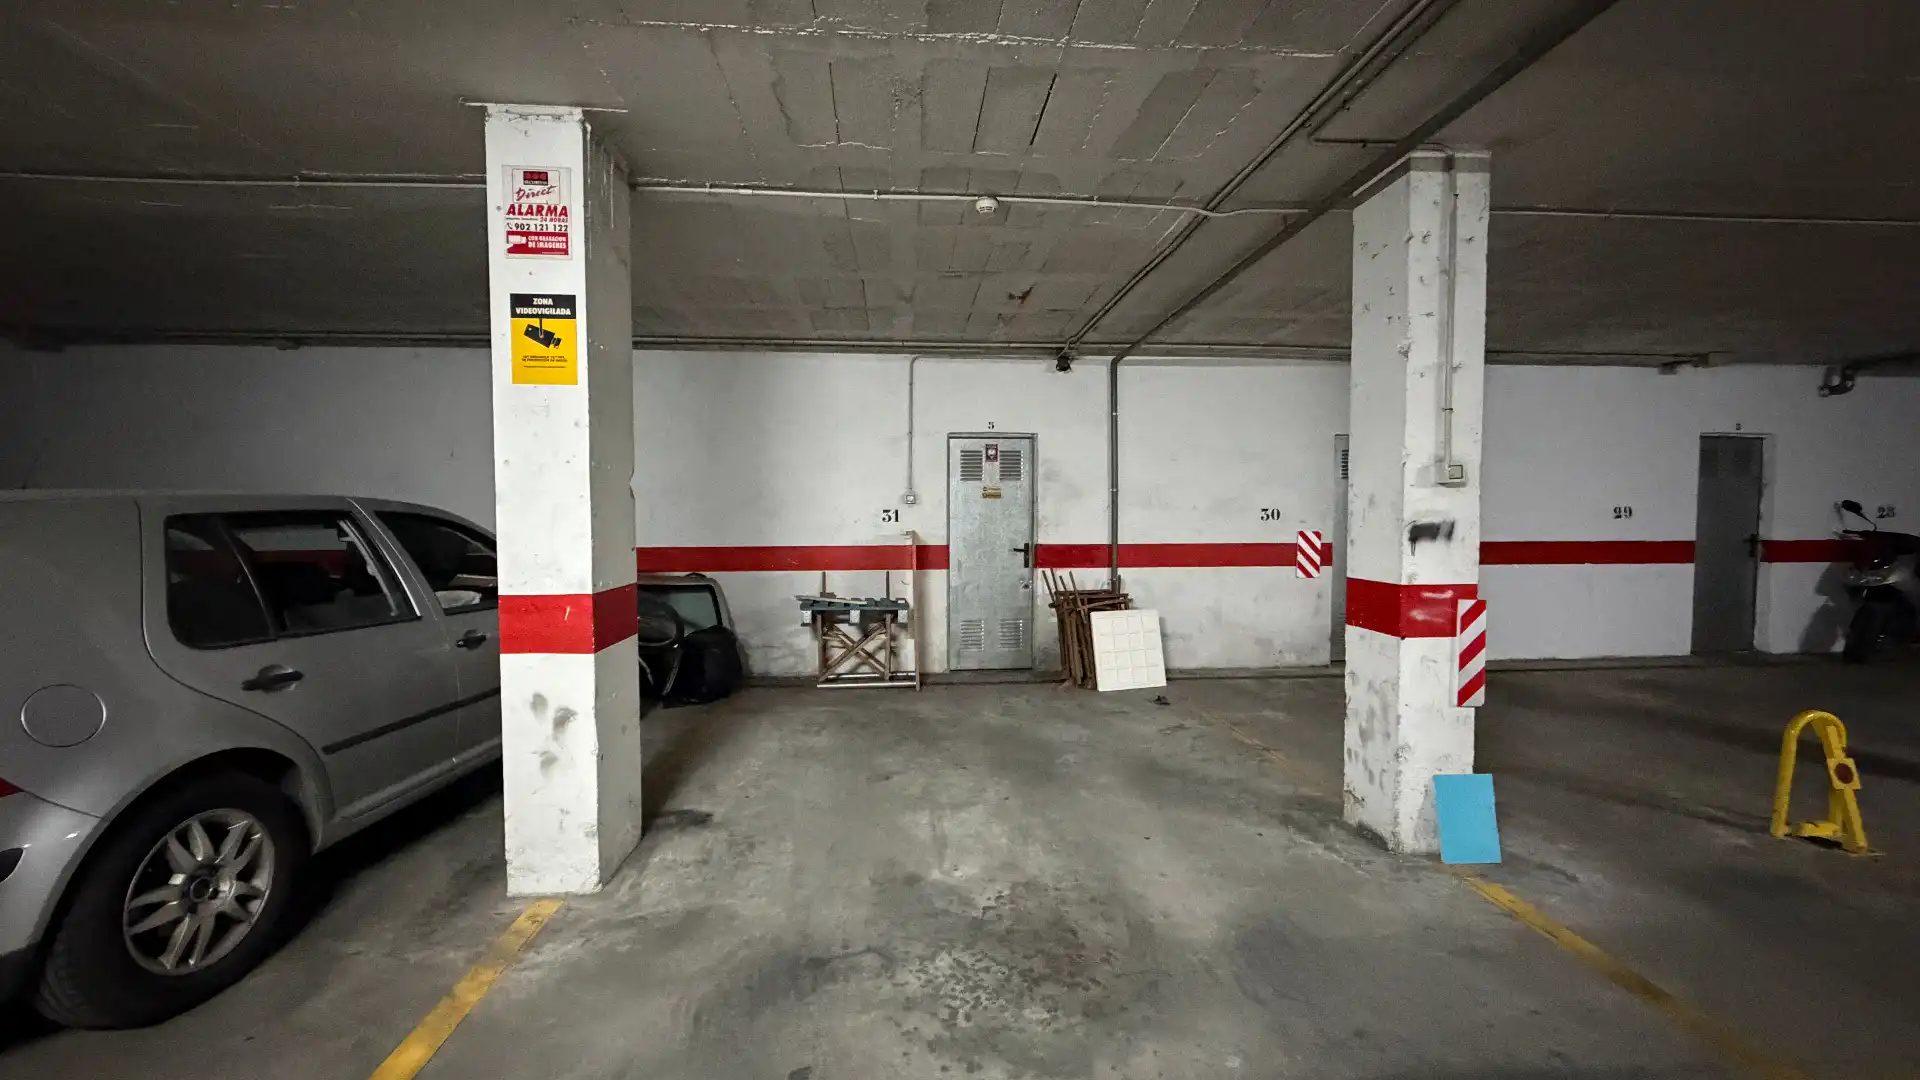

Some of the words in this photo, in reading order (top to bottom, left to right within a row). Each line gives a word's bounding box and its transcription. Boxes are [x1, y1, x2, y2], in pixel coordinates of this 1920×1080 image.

[515, 185, 557, 201] Direct
[506, 204, 568, 217] ALARMA
[514, 223, 530, 231] 902
[553, 224, 568, 232] 122
[515, 307, 571, 315] VIDEOVIGILADA
[882, 509, 900, 522] 31
[1260, 508, 1280, 521] 30
[1613, 506, 1632, 519] 29
